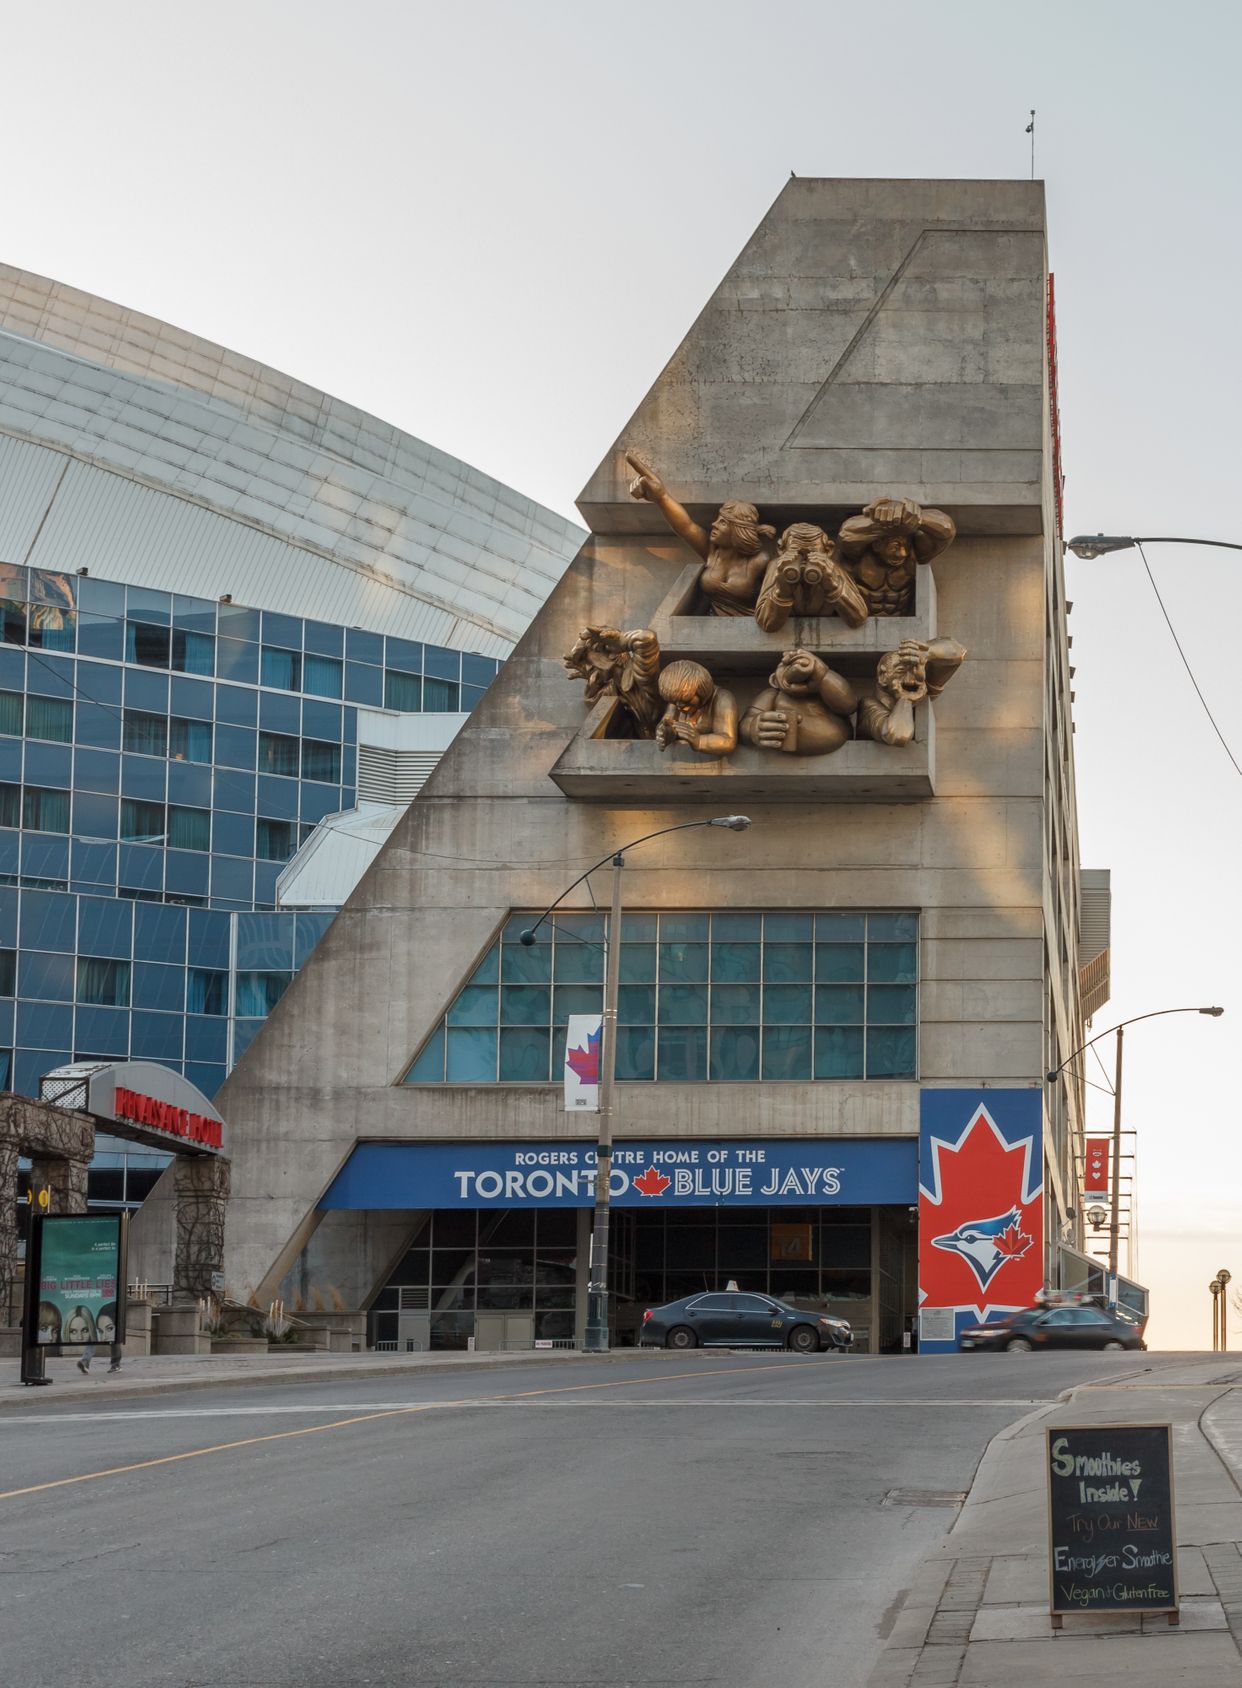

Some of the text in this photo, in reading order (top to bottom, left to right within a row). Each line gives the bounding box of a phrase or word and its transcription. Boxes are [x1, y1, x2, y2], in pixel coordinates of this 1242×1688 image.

[515, 1152, 578, 1166] ROGERS
[653, 1151, 699, 1164] HOME
[707, 1150, 729, 1163] OF
[736, 1150, 766, 1163] THE
[454, 1167, 841, 1199] TORONTO BLUE JAYS
[40, 1279, 117, 1290] BIG LITTLE LIES
[1051, 1437, 1141, 1477] Smoothies
[1079, 1479, 1142, 1504] Inside!
[1066, 1511, 1159, 1543] Try Our NEW
[1121, 1544, 1173, 1569] Smoothie
[1060, 1583, 1105, 1607] Vegan
